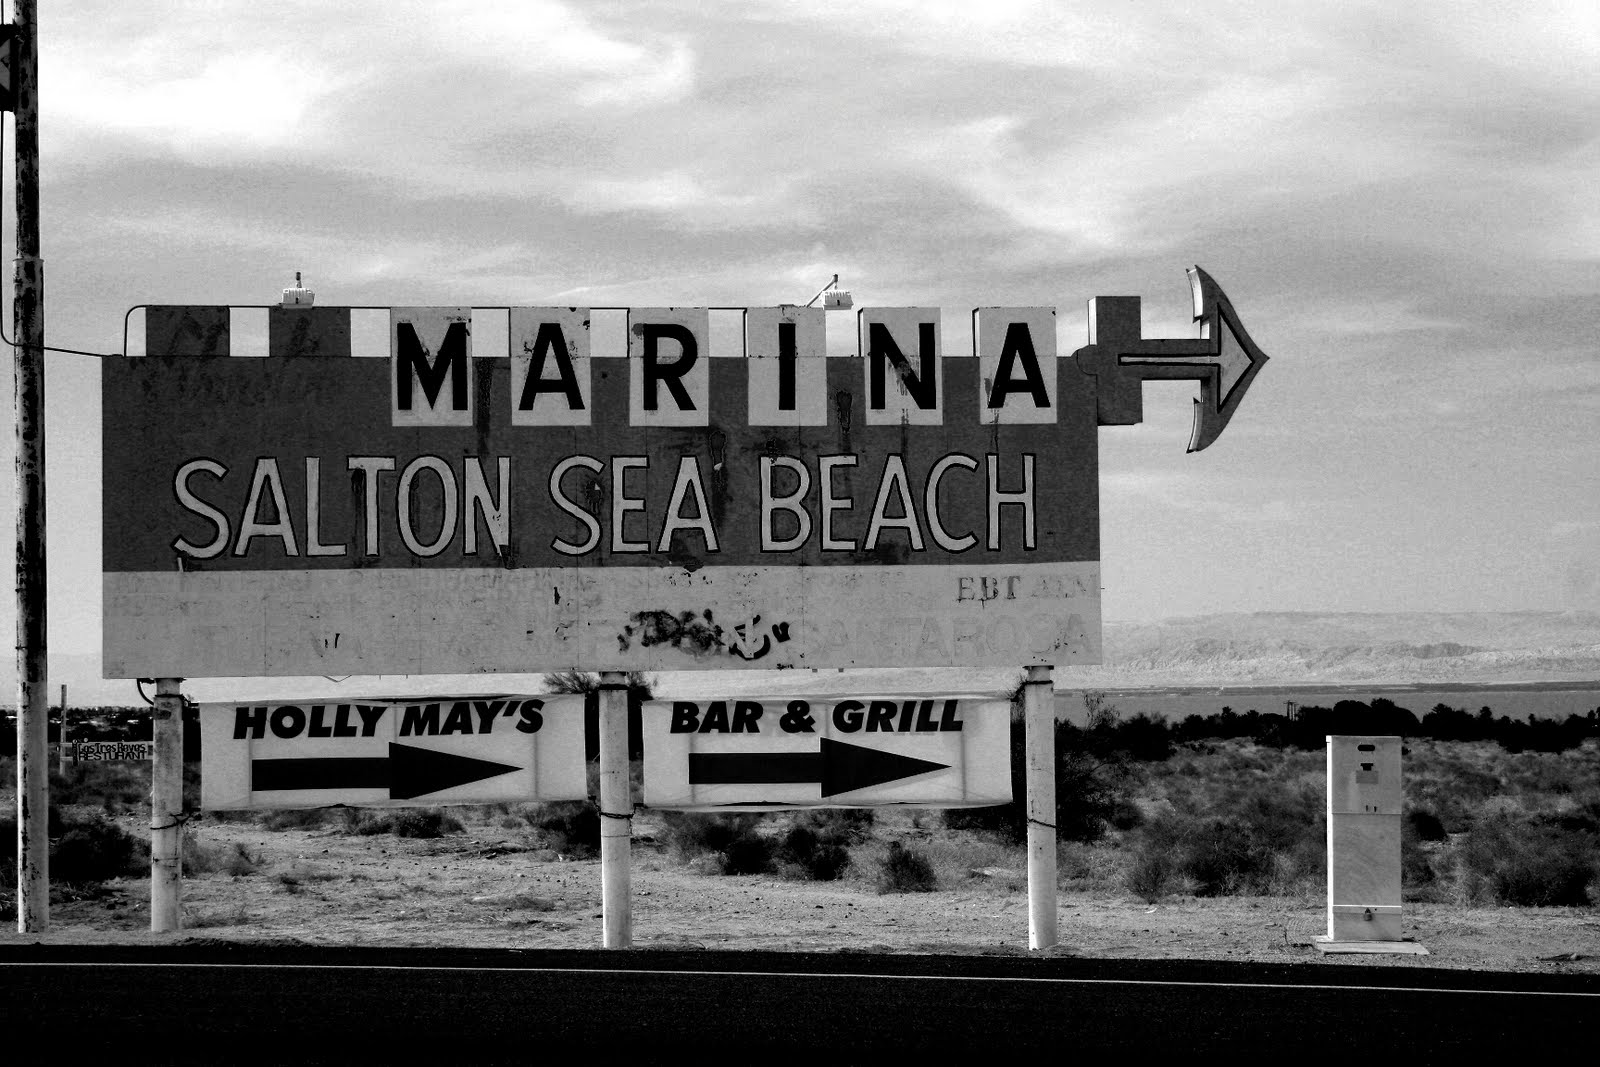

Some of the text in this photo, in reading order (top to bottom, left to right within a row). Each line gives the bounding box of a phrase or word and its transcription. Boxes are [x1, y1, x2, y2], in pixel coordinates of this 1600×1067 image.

[397, 322, 1051, 411] MARINA
[171, 452, 1038, 558] SALTON SEA BEACH
[233, 699, 546, 740] HOLLY MAY'S
[670, 699, 964, 734] BAR & GRILL
